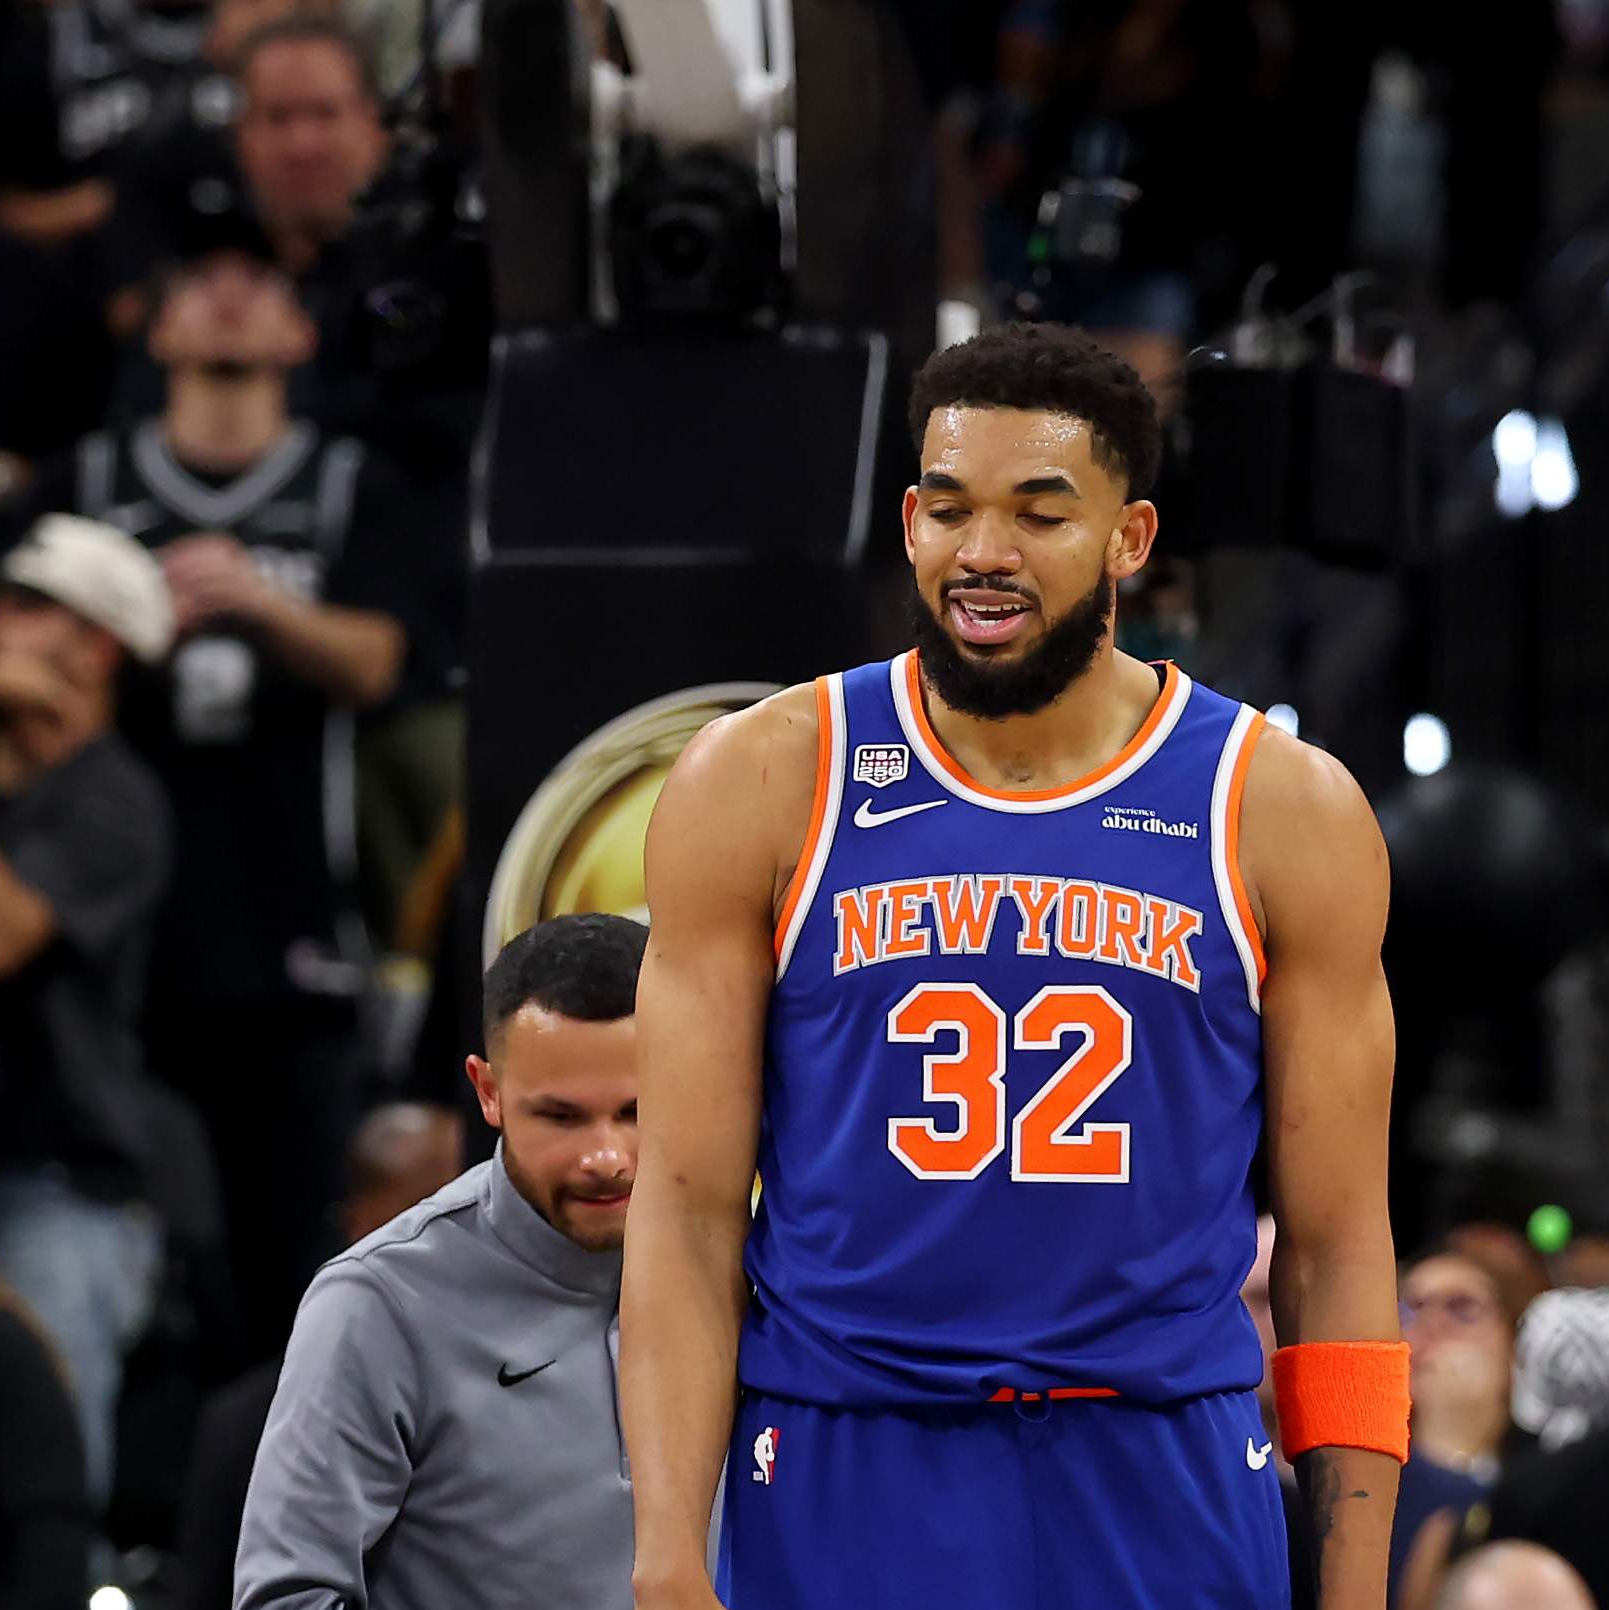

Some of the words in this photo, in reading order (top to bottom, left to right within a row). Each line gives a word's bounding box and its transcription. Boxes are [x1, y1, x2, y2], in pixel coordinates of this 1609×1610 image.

[862, 750, 902, 761] USA
[858, 766, 904, 777] 250
[1104, 805, 1156, 817] experience
[1101, 814, 1140, 831] abu
[1142, 817, 1198, 839] dhabi
[832, 873, 1005, 977] NEW
[1007, 873, 1205, 994] YORK
[887, 982, 1133, 1184] 32
